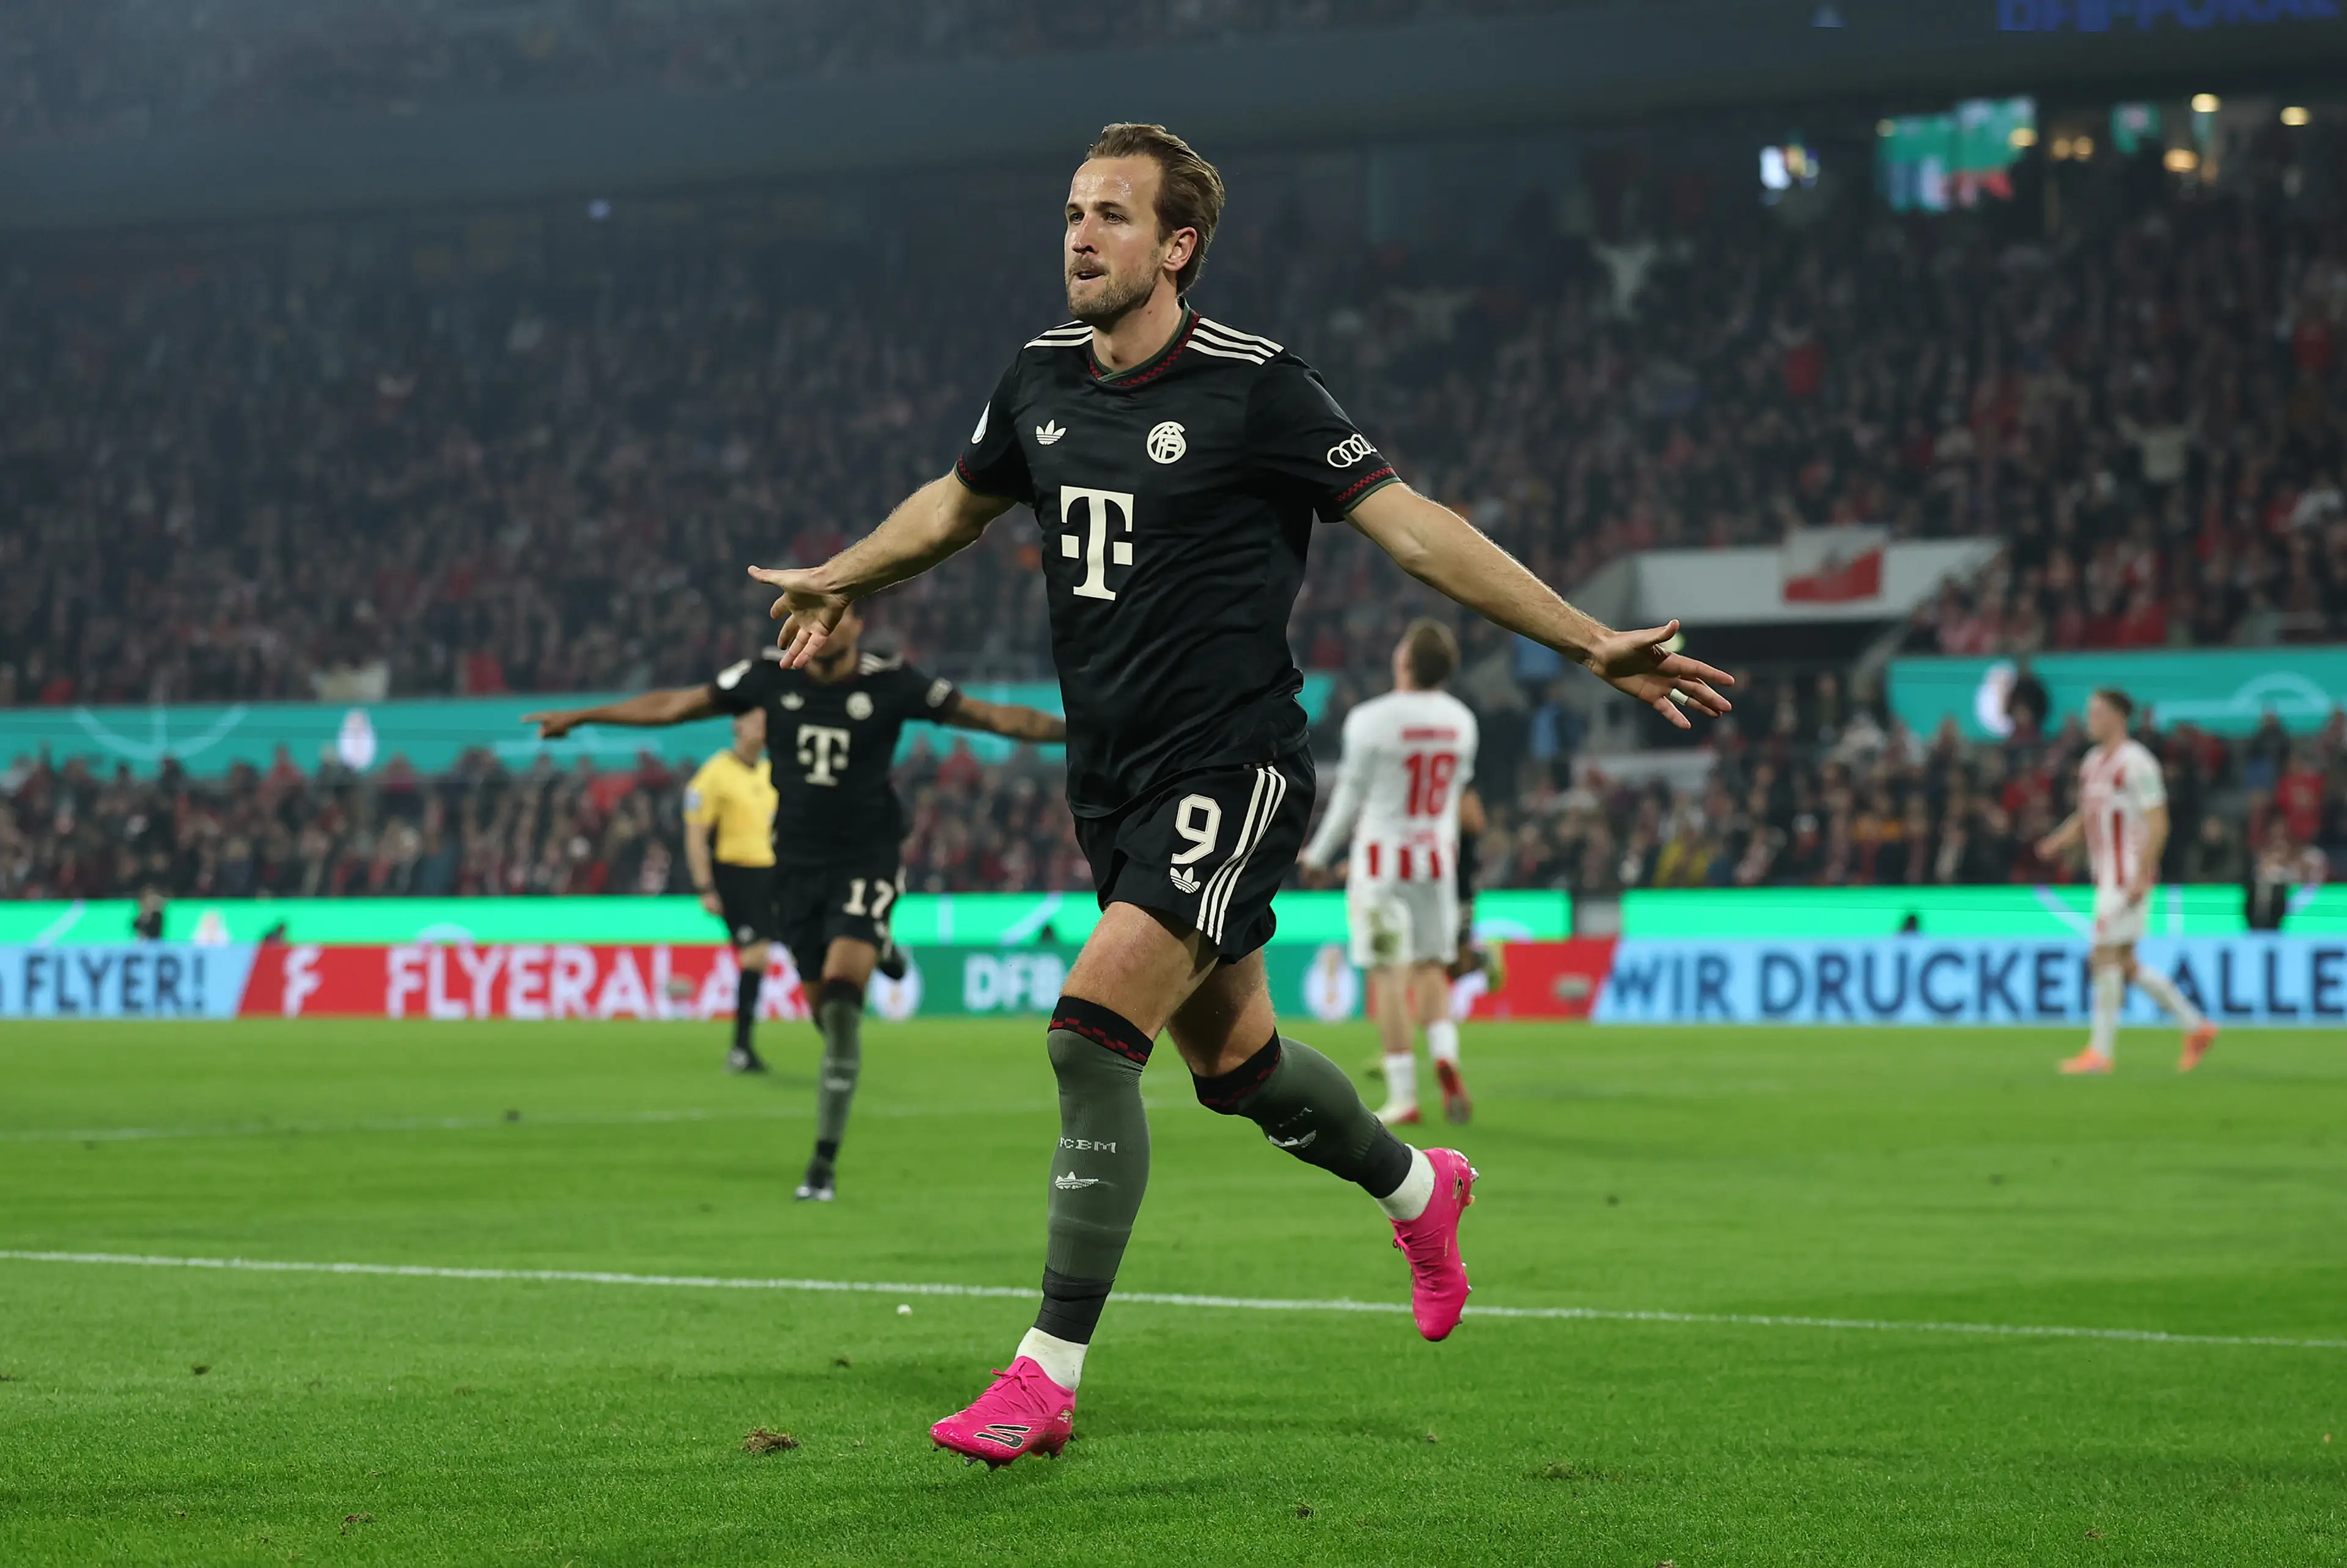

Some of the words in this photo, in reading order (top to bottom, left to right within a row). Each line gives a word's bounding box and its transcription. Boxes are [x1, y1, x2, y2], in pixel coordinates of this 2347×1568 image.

[1060, 485, 1133, 601] T
[1404, 749, 1457, 817] 18
[1171, 794, 1222, 865] 9
[843, 878, 895, 918] 17
[24, 952, 207, 1013] FLYER!
[386, 944, 811, 1020] FLYERALAR
[1609, 953, 1733, 1016] WIR
